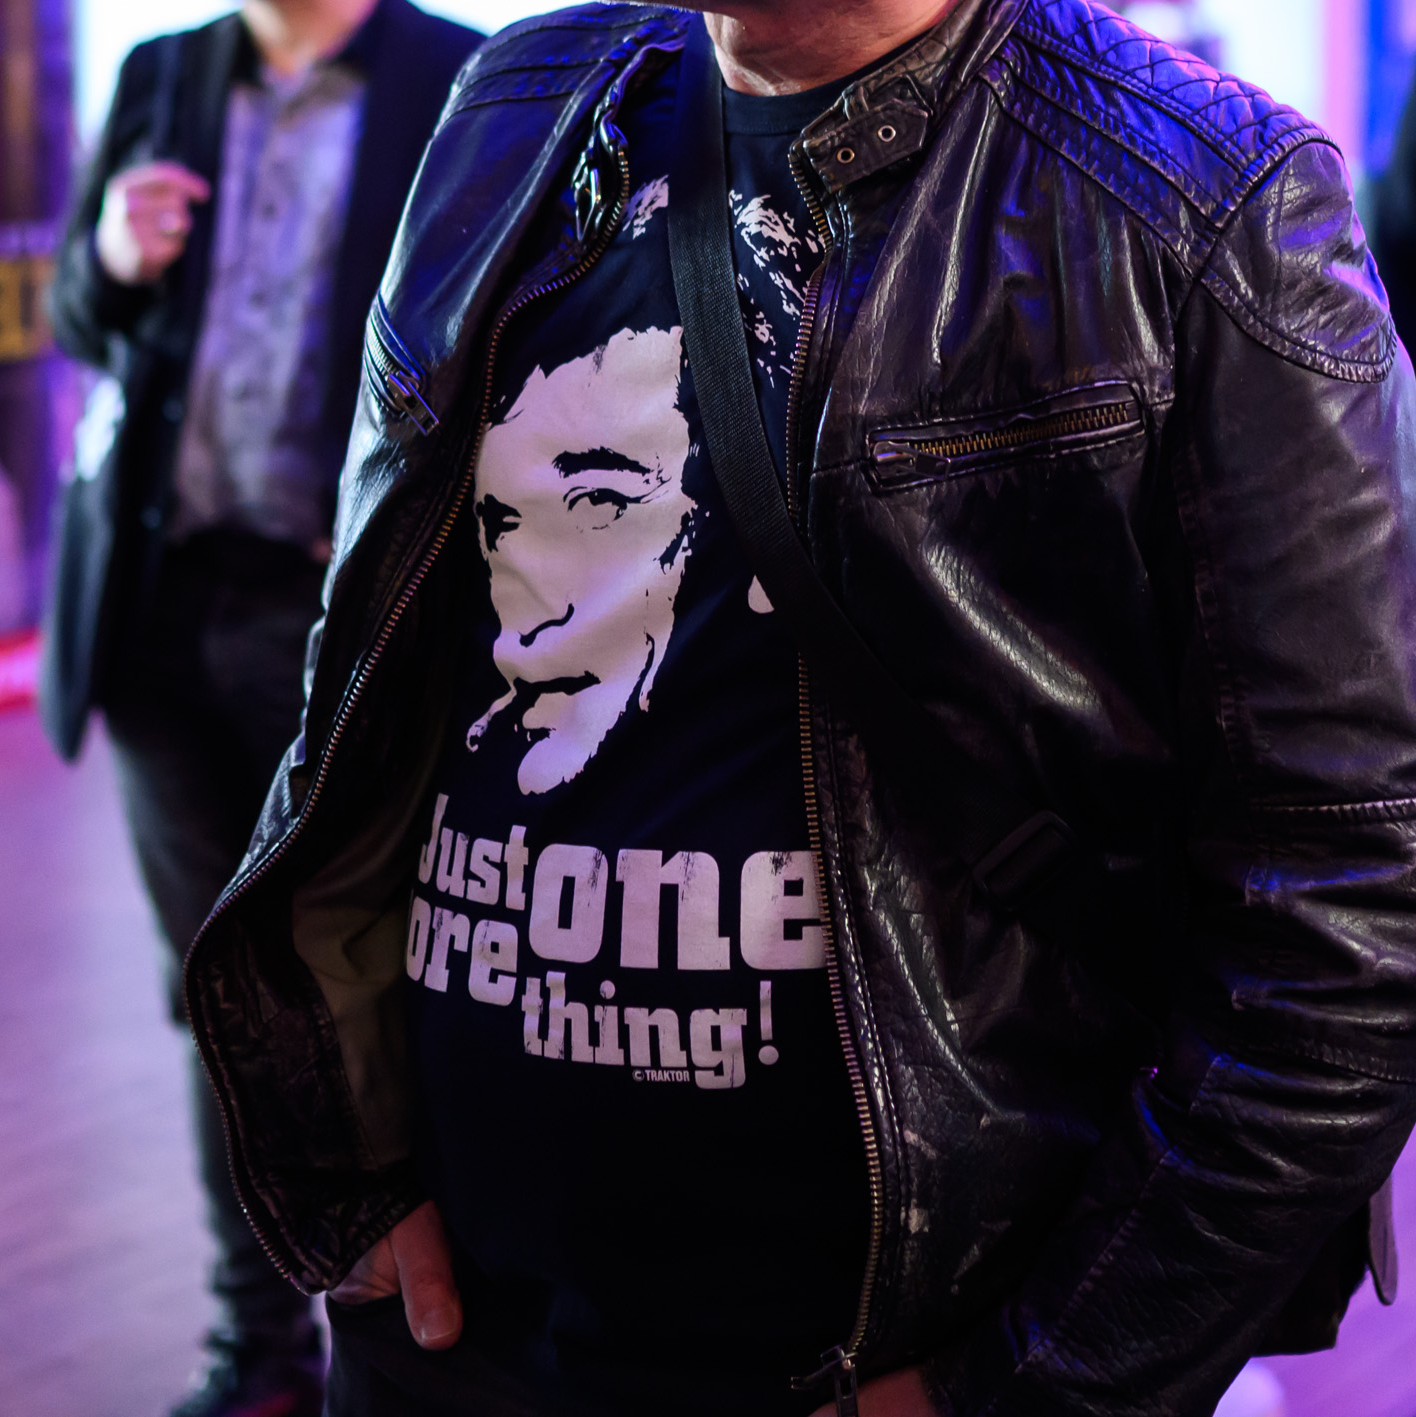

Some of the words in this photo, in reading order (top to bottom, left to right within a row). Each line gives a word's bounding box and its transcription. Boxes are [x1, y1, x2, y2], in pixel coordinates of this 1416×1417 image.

[418, 792, 529, 911] Just
[528, 842, 829, 971] one
[405, 889, 519, 1007] ore
[521, 970, 779, 1090] thing!
